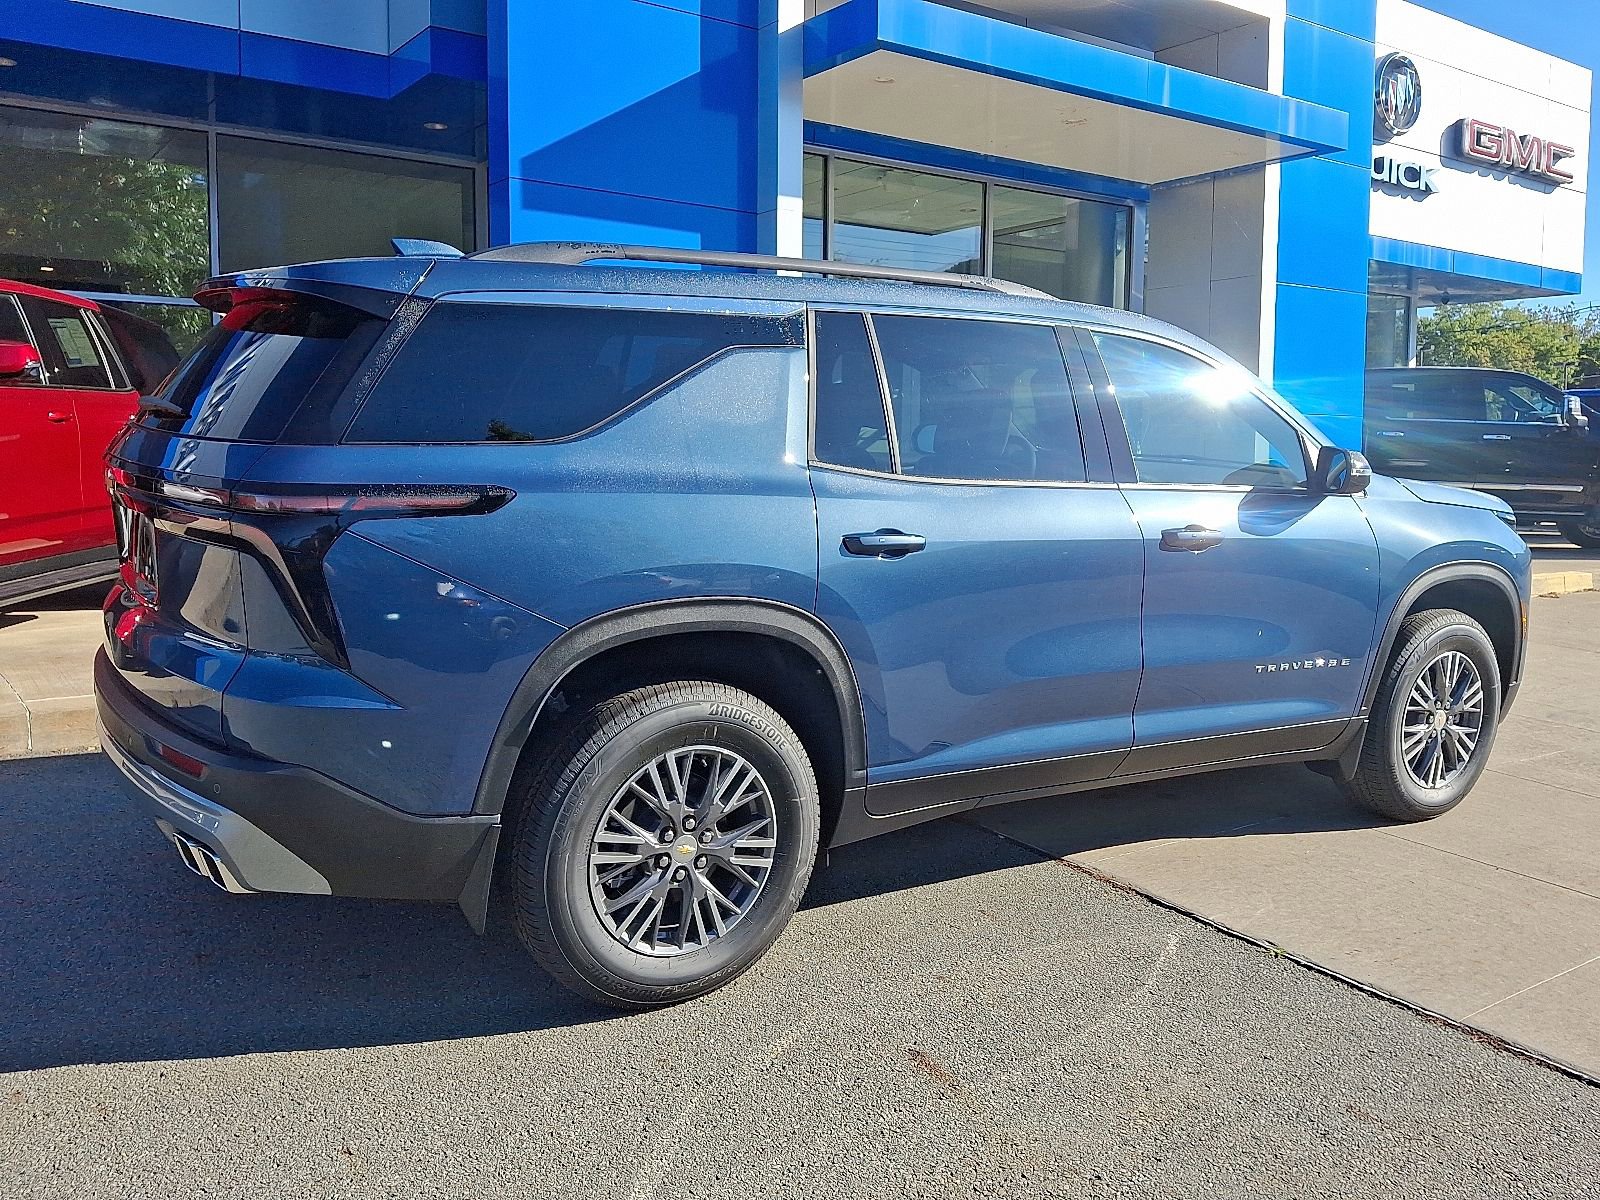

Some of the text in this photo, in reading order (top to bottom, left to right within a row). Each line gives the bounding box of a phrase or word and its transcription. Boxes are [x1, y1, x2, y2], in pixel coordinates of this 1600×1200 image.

[1464, 119, 1575, 183] GMC
[1371, 157, 1440, 192] UICK
[1255, 658, 1350, 673] TRAVERSE
[708, 703, 786, 750] BRIDGESTONE
